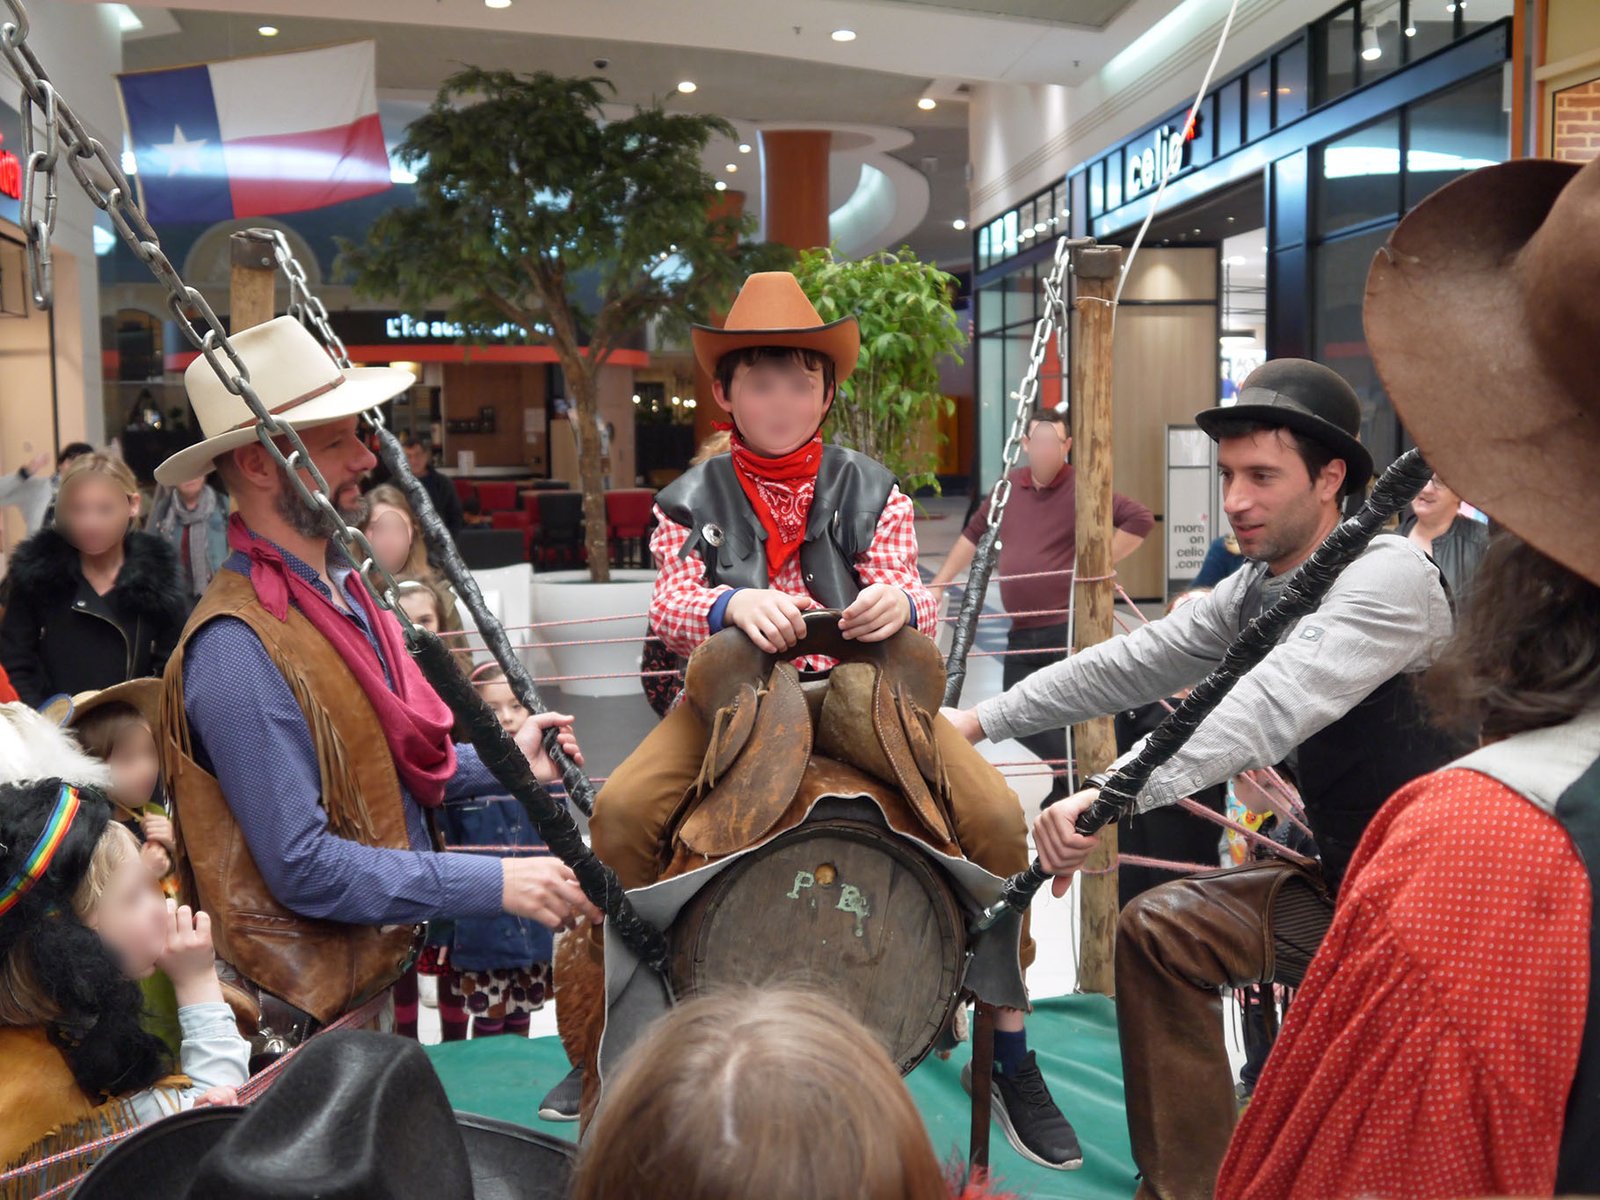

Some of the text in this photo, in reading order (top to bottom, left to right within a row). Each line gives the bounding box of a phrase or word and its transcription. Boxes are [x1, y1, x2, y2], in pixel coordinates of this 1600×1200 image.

[1128, 125, 1183, 197] celio
[1190, 535, 1205, 544] on
[1176, 546, 1205, 557] celio
